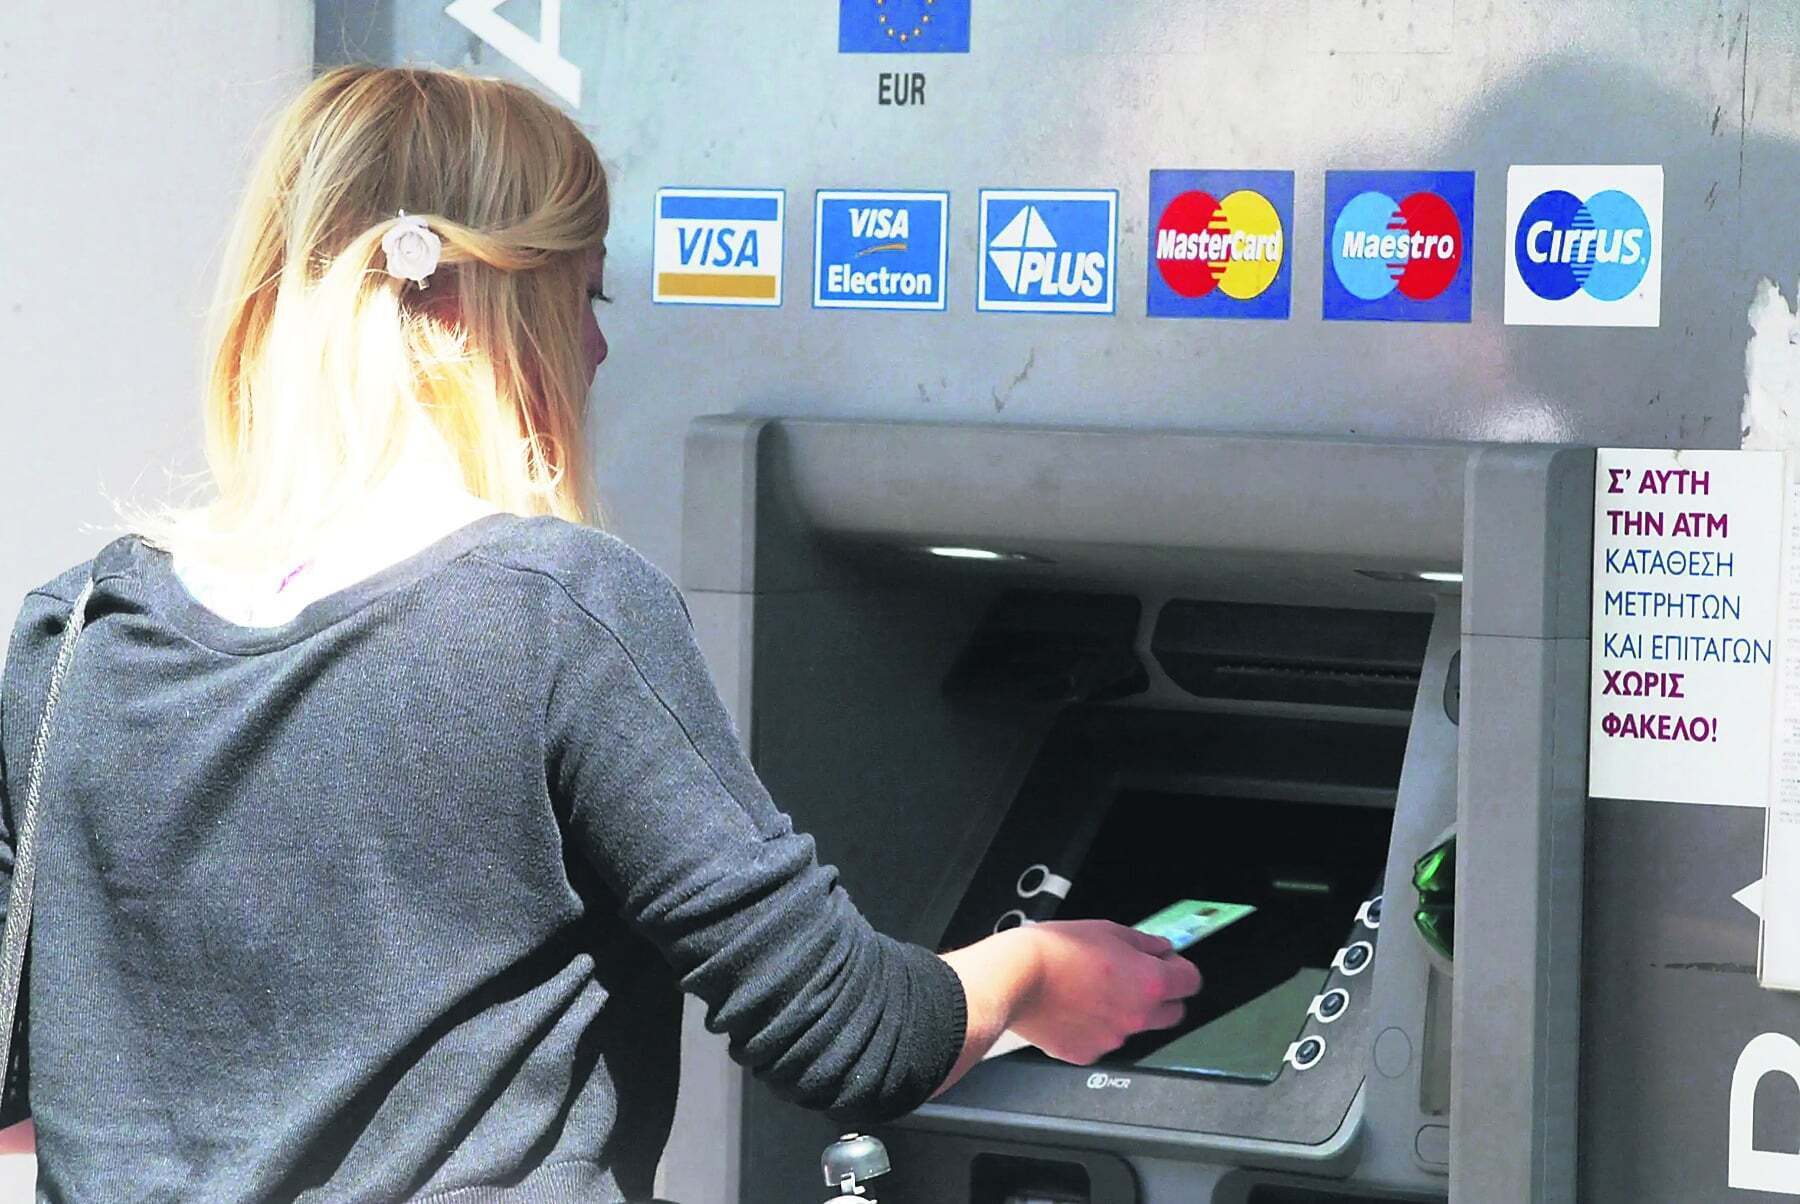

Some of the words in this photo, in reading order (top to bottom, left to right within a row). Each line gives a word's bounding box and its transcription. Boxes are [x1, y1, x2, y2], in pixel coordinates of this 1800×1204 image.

[878, 72, 926, 106] EUR
[849, 208, 910, 239] VISA
[678, 227, 759, 268] VISA
[1155, 228, 1283, 264] MasterCard
[1341, 228, 1454, 260] Maestro
[1525, 220, 1648, 265] Cirrus
[828, 263, 932, 295] Electron
[1017, 250, 1105, 297] PLUS
[1638, 469, 1710, 496] ΑΥΤΗ
[1606, 510, 1664, 537] ΤΗΝ
[1605, 548, 1733, 577] ΚΑΤΑΘΕΣΗ
[1604, 590, 1740, 620] ΜΕΤΡΗΤΩΝ
[1604, 632, 1642, 660] ΚΑΙ
[1652, 634, 1772, 665] ΕΠΙΤΑΓΩΝ
[1602, 669, 1685, 699] ΧΩΡΙΣ
[1601, 711, 1717, 743] ΦΑΚΕΛΟ!
